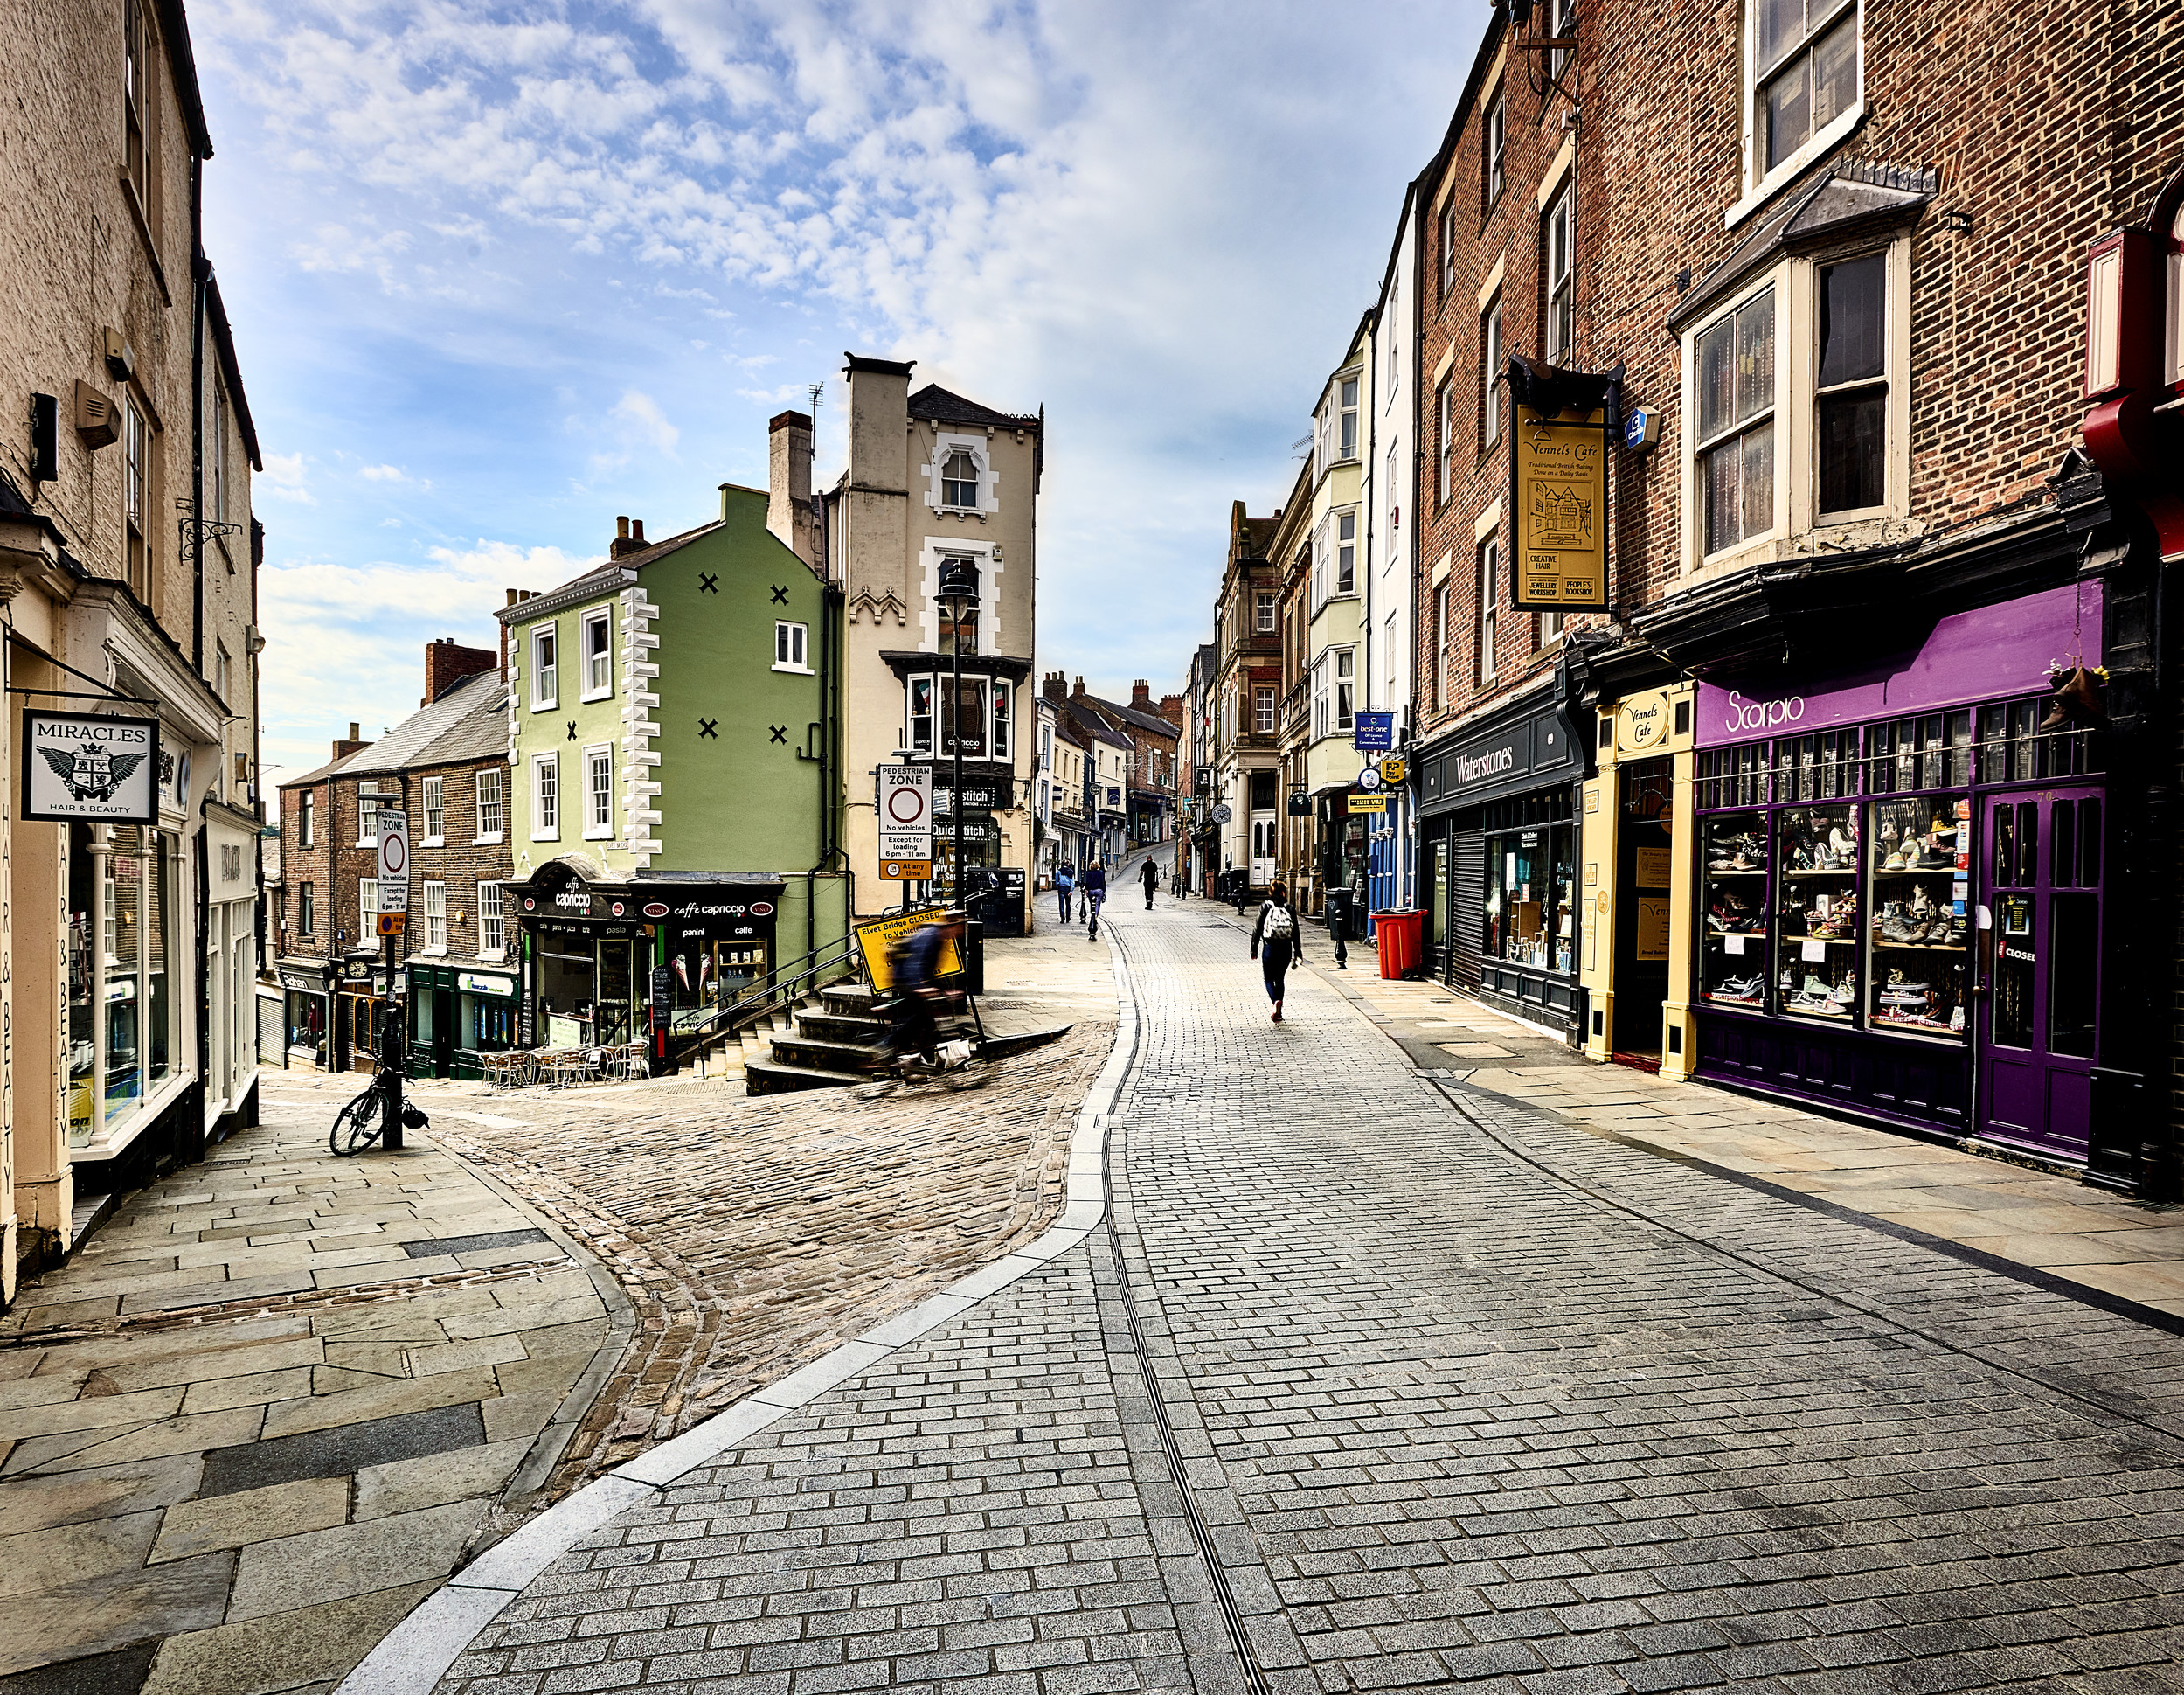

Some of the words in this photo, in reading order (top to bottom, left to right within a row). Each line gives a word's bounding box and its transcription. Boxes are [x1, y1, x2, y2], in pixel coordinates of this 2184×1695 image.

[1523, 441, 1570, 455] Vennels
[1574, 443, 1598, 461] Cafe
[1576, 463, 1594, 472] Baking
[1626, 703, 1658, 723] Vennels
[1725, 690, 1805, 733] Scorpio
[37, 723, 147, 744] MIRACLES
[1634, 721, 1652, 743] Cafe
[1455, 746, 1513, 785] Waterstones
[889, 775, 923, 785] ZONE
[2037, 791, 2052, 802] 70
[50, 803, 76, 812] HAIR
[89, 805, 131, 814] BEAUTY
[378, 810, 406, 821] PEDESTRIAN
[383, 819, 404, 831] ZONE
[888, 837, 911, 845] Except
[893, 844, 918, 853] loading
[384, 886, 399, 895] Except
[555, 893, 591, 910] capriccio
[701, 905, 745, 916] capriccio
[1641, 902, 1671, 917] Venn
[862, 925, 882, 936] Elvet
[883, 920, 907, 931] Bridge
[908, 911, 940, 925] CLOSED
[683, 927, 705, 938] panini
[883, 932, 892, 941] To
[59, 938, 67, 967] &
[3, 951, 10, 983] &
[283, 973, 309, 989] Rohan
[1700, 991, 1765, 1005] www.scorpioshoes.co
[59, 981, 68, 1147] BEAUTY
[3, 1001, 12, 1195] BEAUTY
